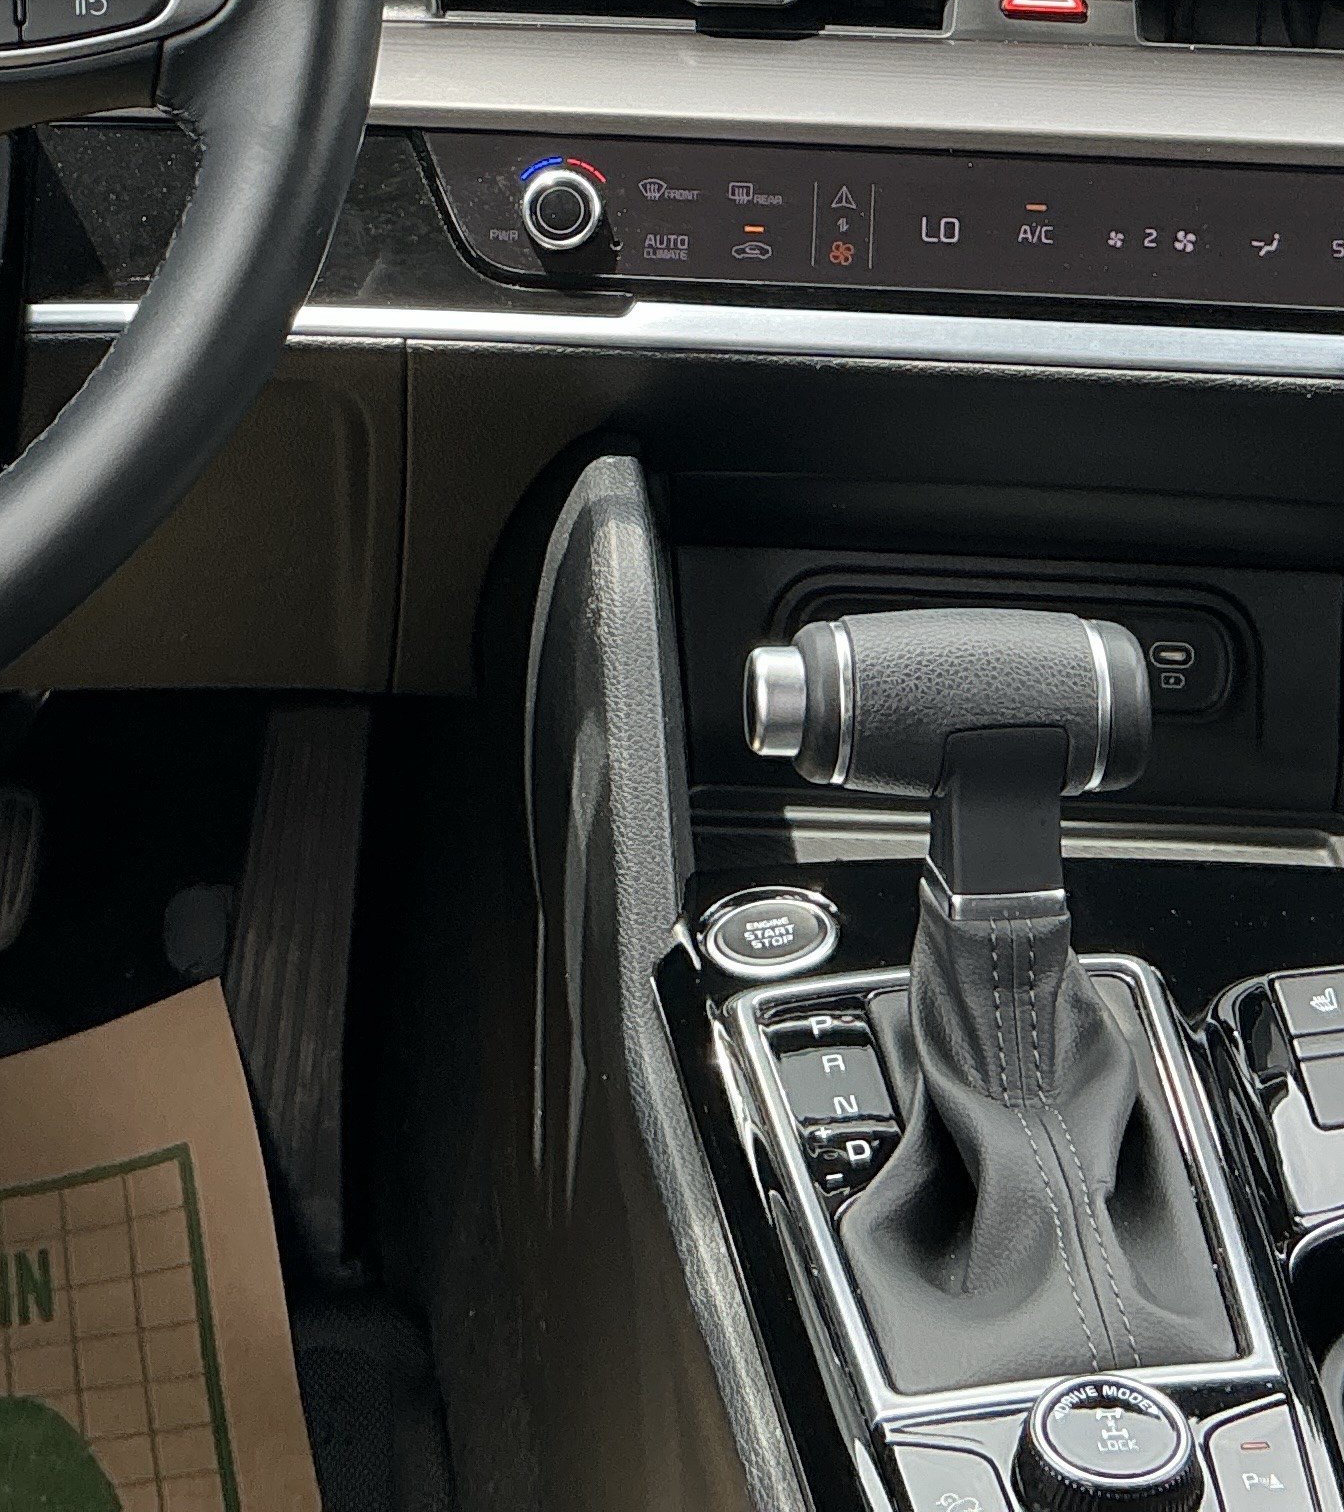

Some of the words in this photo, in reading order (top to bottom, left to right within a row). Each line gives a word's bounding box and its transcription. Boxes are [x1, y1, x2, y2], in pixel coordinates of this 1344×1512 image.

[664, 188, 702, 201] FRONT
[753, 193, 783, 206] REAR
[489, 228, 519, 242] PWR
[921, 216, 961, 244] LO
[1017, 224, 1055, 245] A/C
[643, 233, 689, 249] AUTO
[1143, 229, 1158, 249] 2
[643, 248, 689, 261] CLIMATE
[745, 915, 790, 931] ENGINE
[744, 924, 795, 941] START
[750, 934, 794, 949] STOP
[810, 1015, 833, 1038] P
[821, 1053, 846, 1074] R
[833, 1094, 859, 1116] N
[845, 1139, 872, 1162] D
[1056, 1385, 1099, 1417] DRIVE
[1102, 1384, 1155, 1412] MODE
[1097, 1438, 1140, 1452] LOCK
